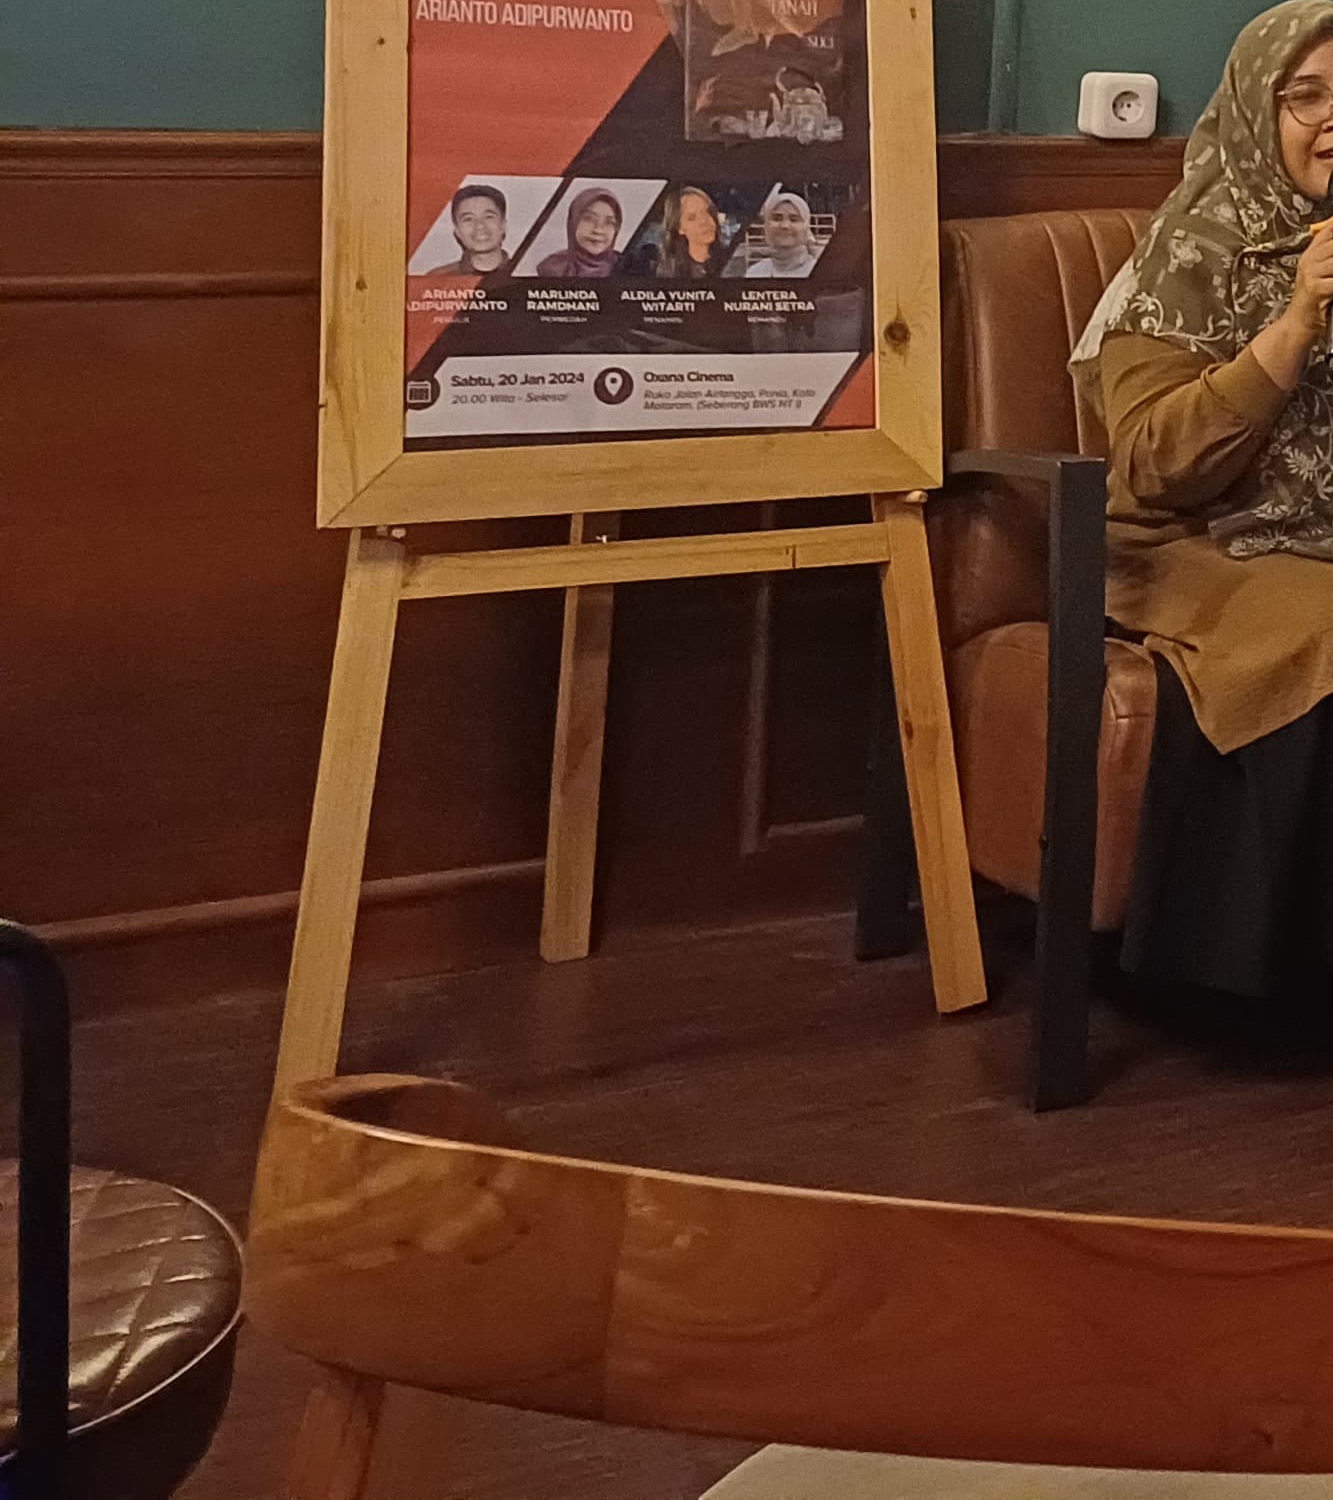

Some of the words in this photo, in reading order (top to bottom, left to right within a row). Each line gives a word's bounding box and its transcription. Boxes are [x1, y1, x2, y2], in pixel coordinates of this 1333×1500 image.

[502, 4, 633, 32] ADIPURWANTO
[422, 288, 486, 299] ARIANTO
[528, 289, 597, 300] MARLINDA
[621, 290, 666, 301] ALDILA
[668, 290, 715, 301] YUNITA
[742, 290, 797, 301] LENTERA
[526, 301, 600, 312] RAMDHANI
[641, 301, 695, 313] WITARTI
[724, 301, 772, 313] NURANI
[775, 301, 815, 313] SETRA
[498, 373, 518, 386] 20
[520, 373, 544, 386] Jan
[547, 372, 586, 385] 2024
[643, 372, 684, 383] Oxana
[687, 371, 734, 383] Cinema
